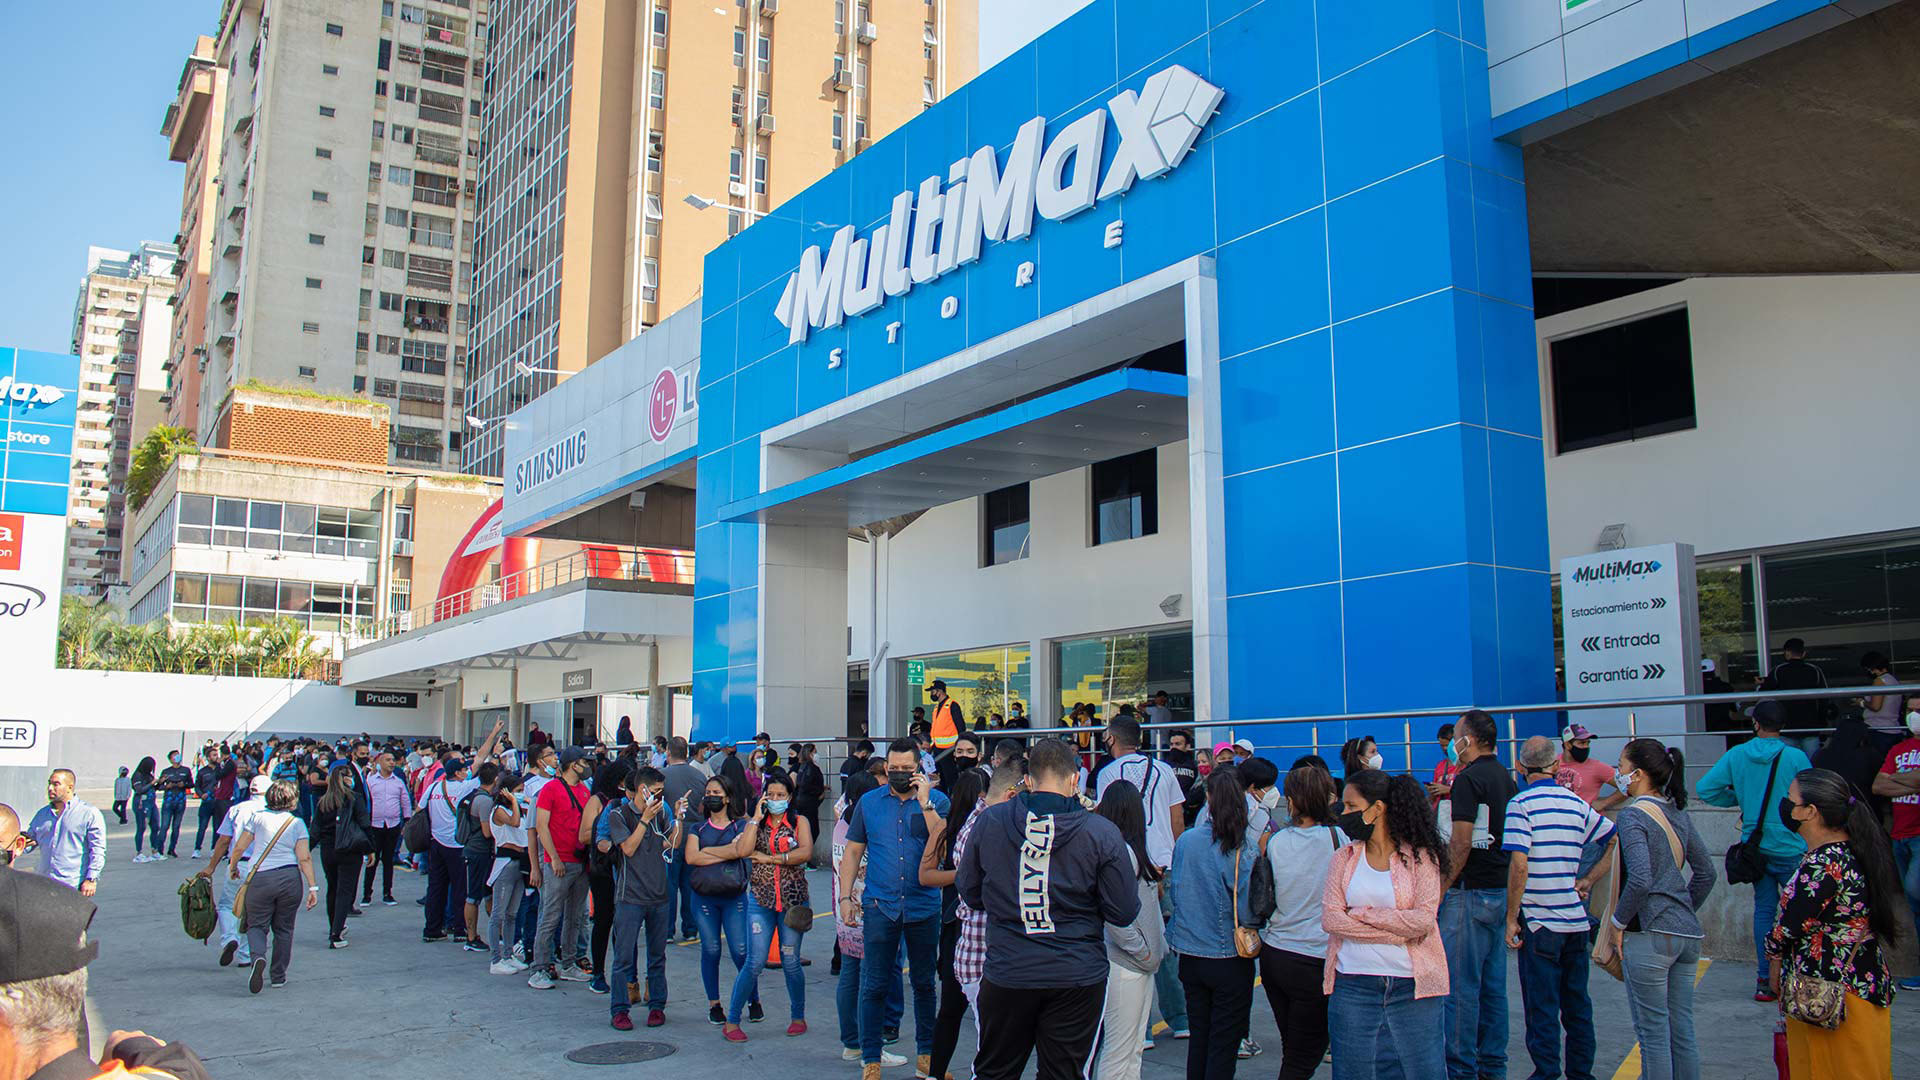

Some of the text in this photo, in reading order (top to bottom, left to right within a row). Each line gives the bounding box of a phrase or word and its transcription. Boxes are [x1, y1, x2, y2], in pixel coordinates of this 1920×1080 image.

[787, 65, 1198, 346] MultiMax
[828, 219, 1124, 370] STORE
[9, 431, 51, 445] store
[516, 430, 586, 495] SAMSUNG
[1576, 560, 1656, 583] MultiMax
[1571, 601, 1649, 618] Estacionamiento
[1604, 632, 1660, 649] Entrada
[567, 673, 584, 687] Salida
[1579, 666, 1639, 684] Garantía
[366, 693, 407, 704] Prueba
[0, 727, 28, 740] ER
[1023, 862, 1051, 931] HELLY
